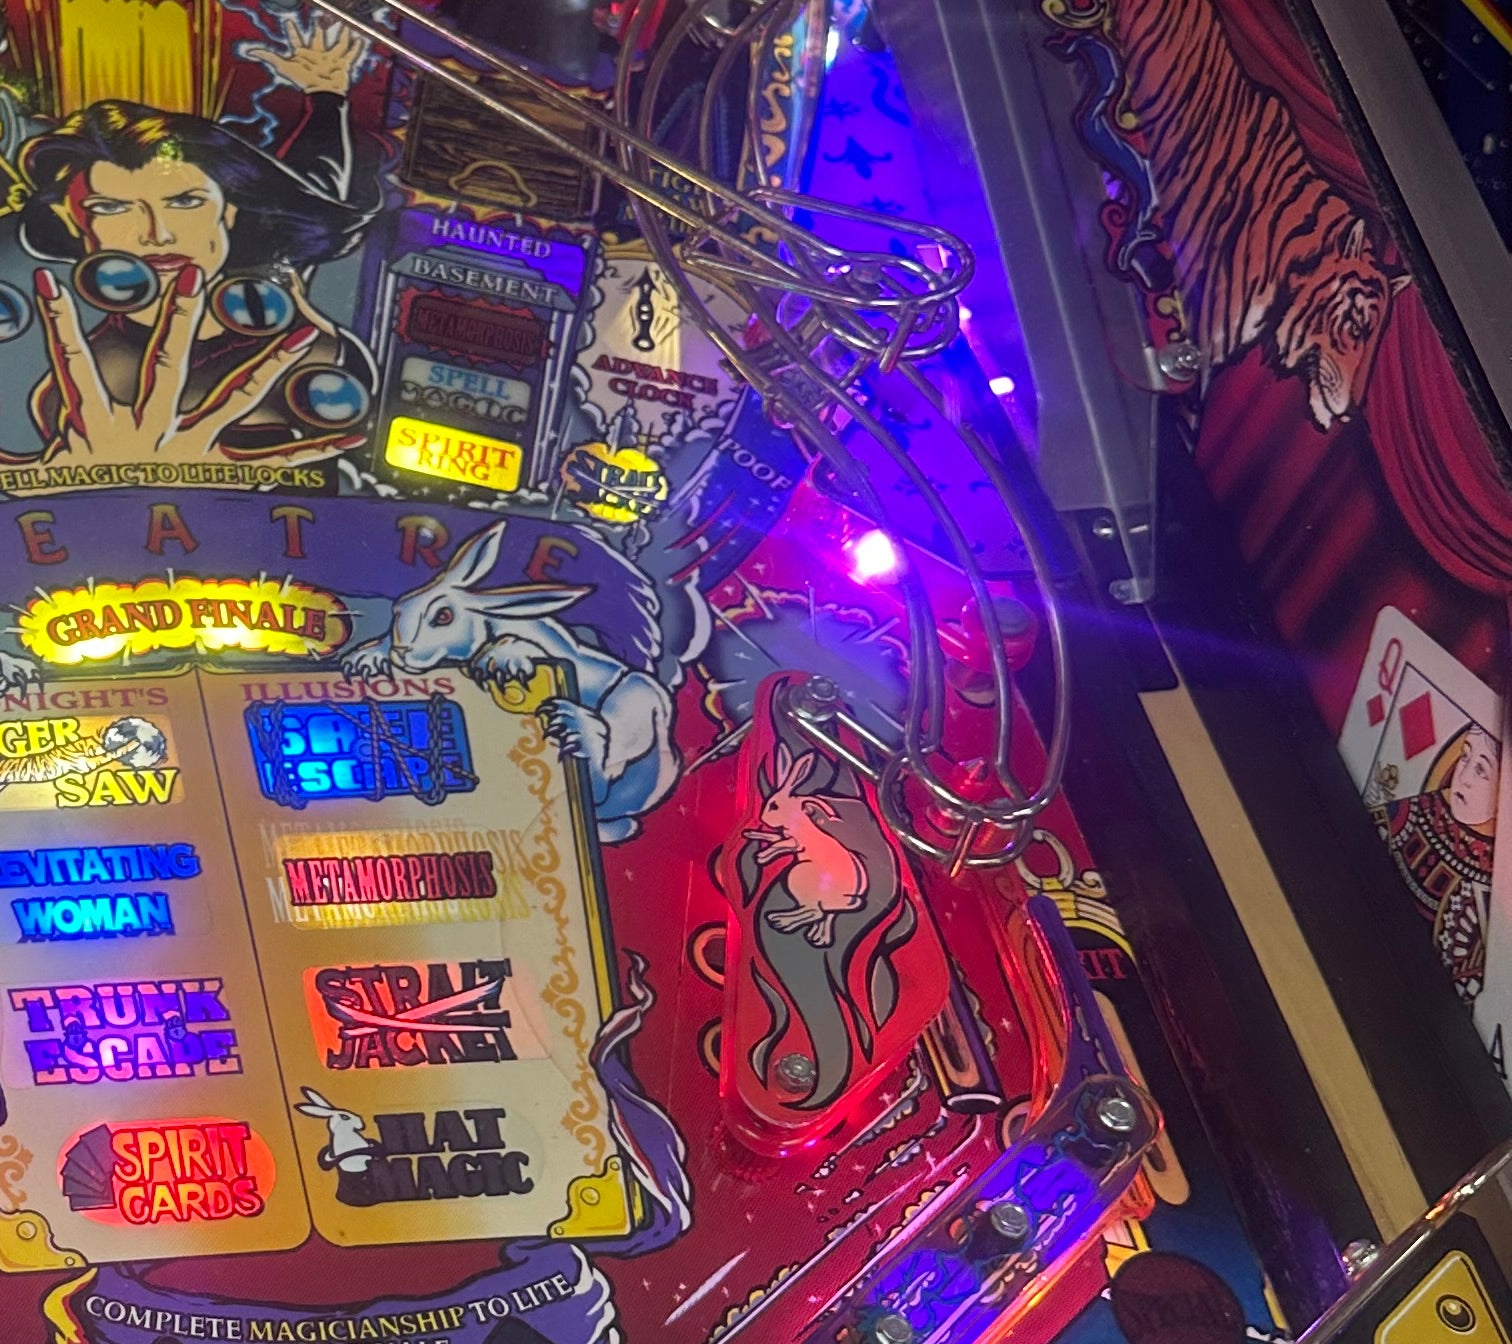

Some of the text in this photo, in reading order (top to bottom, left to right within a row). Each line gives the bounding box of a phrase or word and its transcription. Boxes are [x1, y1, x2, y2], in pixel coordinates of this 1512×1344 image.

[432, 218, 551, 259] HAUNTED
[414, 257, 558, 304] BASEMENT
[427, 365, 511, 400] SPELL
[592, 354, 720, 397] ADVANCE
[608, 377, 695, 409] CLOCK
[398, 427, 515, 471] SPIRIT
[418, 452, 490, 482] RING
[718, 434, 793, 490] POOF
[48, 464, 137, 487] MAGIC
[137, 463, 180, 483] TO
[180, 464, 242, 484] LITE
[242, 465, 327, 488] LOCKS
[46, 598, 327, 647] GRAND FINALE
[241, 676, 456, 701] ILLUSIONS
[55, 768, 181, 808] SAW
[283, 850, 498, 906] METAMORPHOSIS
[11, 892, 175, 940] WOMAN
[7, 977, 231, 1033] TRUNK
[315, 958, 513, 1026] STRAIT
[24, 1029, 243, 1086] ESCAPE
[326, 1010, 519, 1070] JACKET
[111, 1121, 252, 1182] SPIRIT
[373, 1107, 506, 1156] HAT
[119, 1176, 265, 1225] CARDS
[369, 1150, 535, 1204] MAGIC
[86, 1273, 574, 1341] COMPLETE MAGICIANSHIP TO LITE
